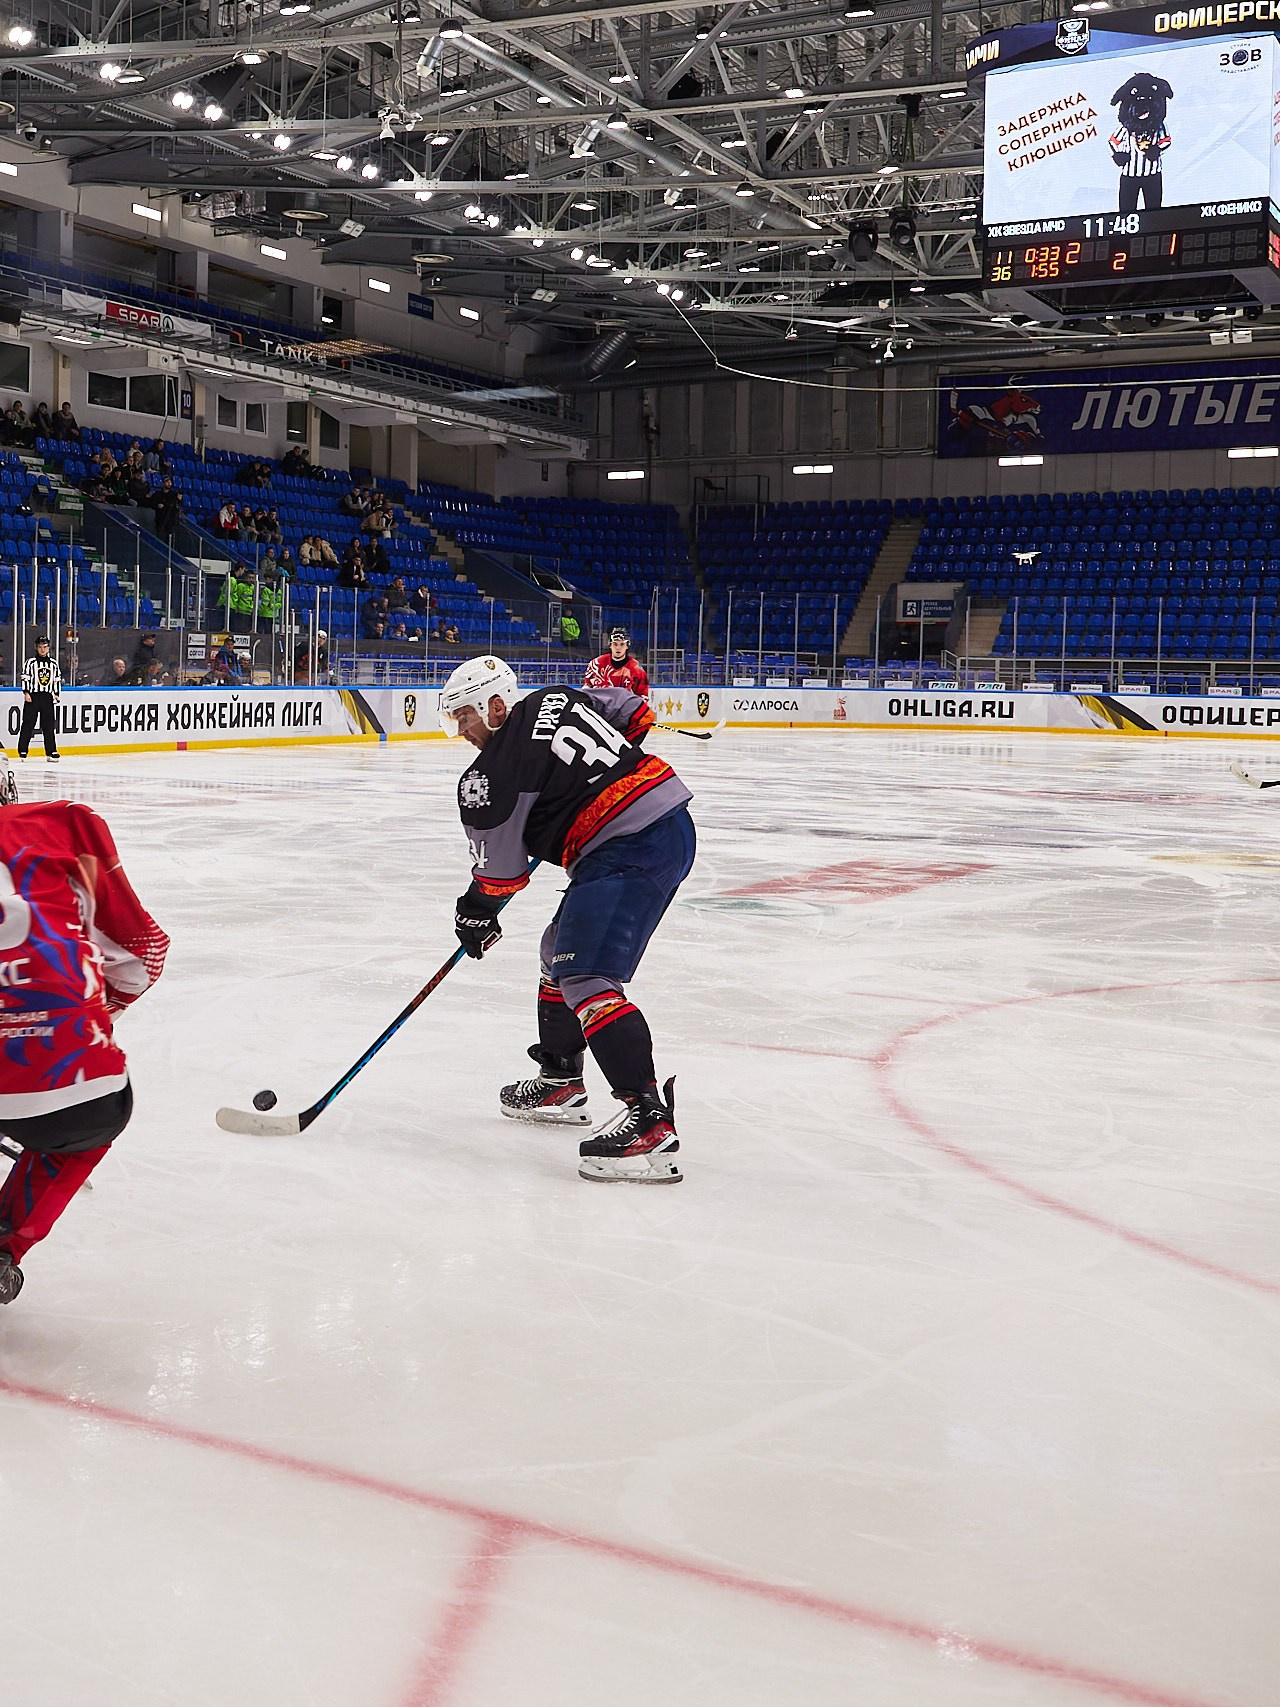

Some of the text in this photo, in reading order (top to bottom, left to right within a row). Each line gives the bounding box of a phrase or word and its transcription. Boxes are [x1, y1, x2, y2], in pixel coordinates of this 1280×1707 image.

[1154, 0, 1280, 33] ОФИЦЕРСК
[997, 92, 1087, 137] ЗАДЕРЖКА
[998, 107, 1098, 156] СОПЕРНИКА
[1007, 124, 1098, 172] КЛЮШКОЙ
[1200, 204, 1217, 218] ХК
[988, 226, 1002, 239] ХК
[1083, 213, 1140, 239] 11:48
[1024, 246, 1060, 264] 0:33
[1065, 242, 1081, 264] 2
[1113, 252, 1127, 271] 2
[991, 261, 1060, 282] 36 1:55
[118, 307, 161, 328] SPAR
[183, 393, 191, 408] 10
[1071, 381, 1280, 431] ЛЮТЫЕ
[931, 681, 956, 690] PARI
[977, 682, 1003, 691] PARI
[7, 694, 322, 736] ОЦЕРСКАЯ ХОККЕЙНАЯ ЛИГА
[888, 698, 1015, 719] OHLIGA.RU
[1162, 704, 1280, 726] ОФИЦЕР
[0, 1026, 54, 1039] РОССИИ
